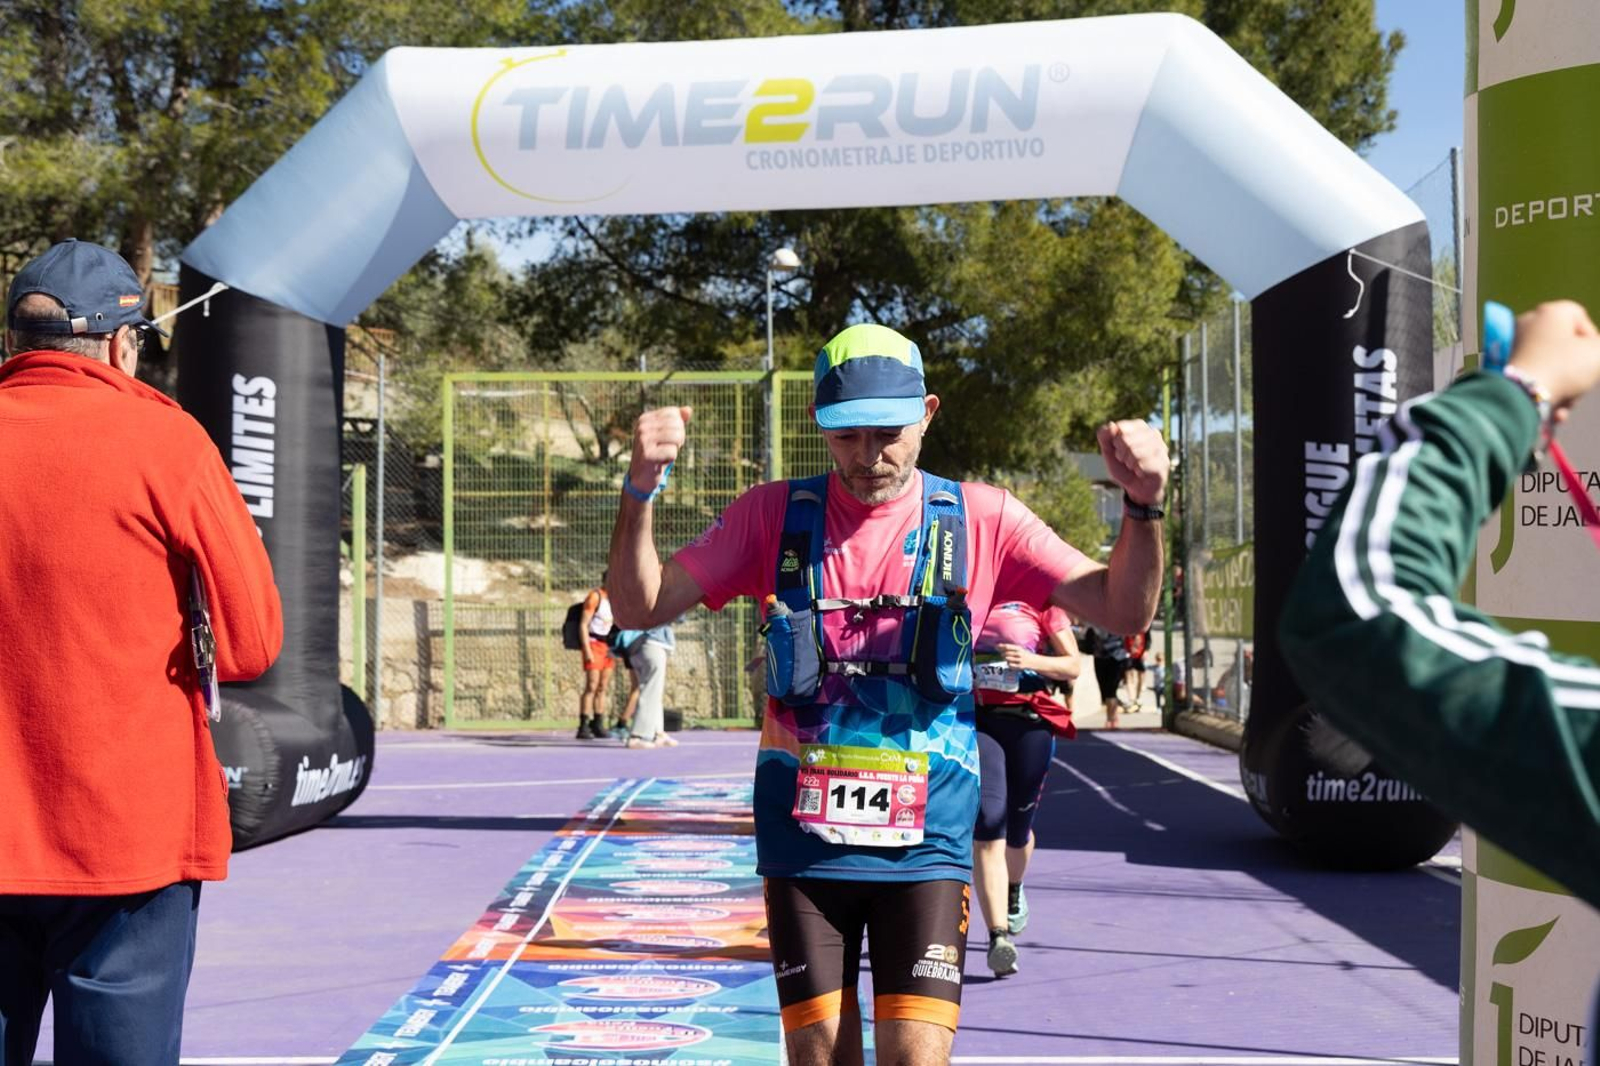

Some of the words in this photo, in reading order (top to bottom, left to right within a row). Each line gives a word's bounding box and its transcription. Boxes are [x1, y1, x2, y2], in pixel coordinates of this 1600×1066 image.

[502, 64, 1041, 151] TIME2RUN
[745, 144, 917, 171] CRONOMETRAJE
[923, 137, 1045, 164] DEPORTIVO
[1495, 193, 1600, 229] DEPOR
[232, 373, 277, 518] LIMITES
[1521, 505, 1548, 527] DE
[831, 785, 889, 812] 114
[1519, 1011, 1588, 1047] DIPUT
